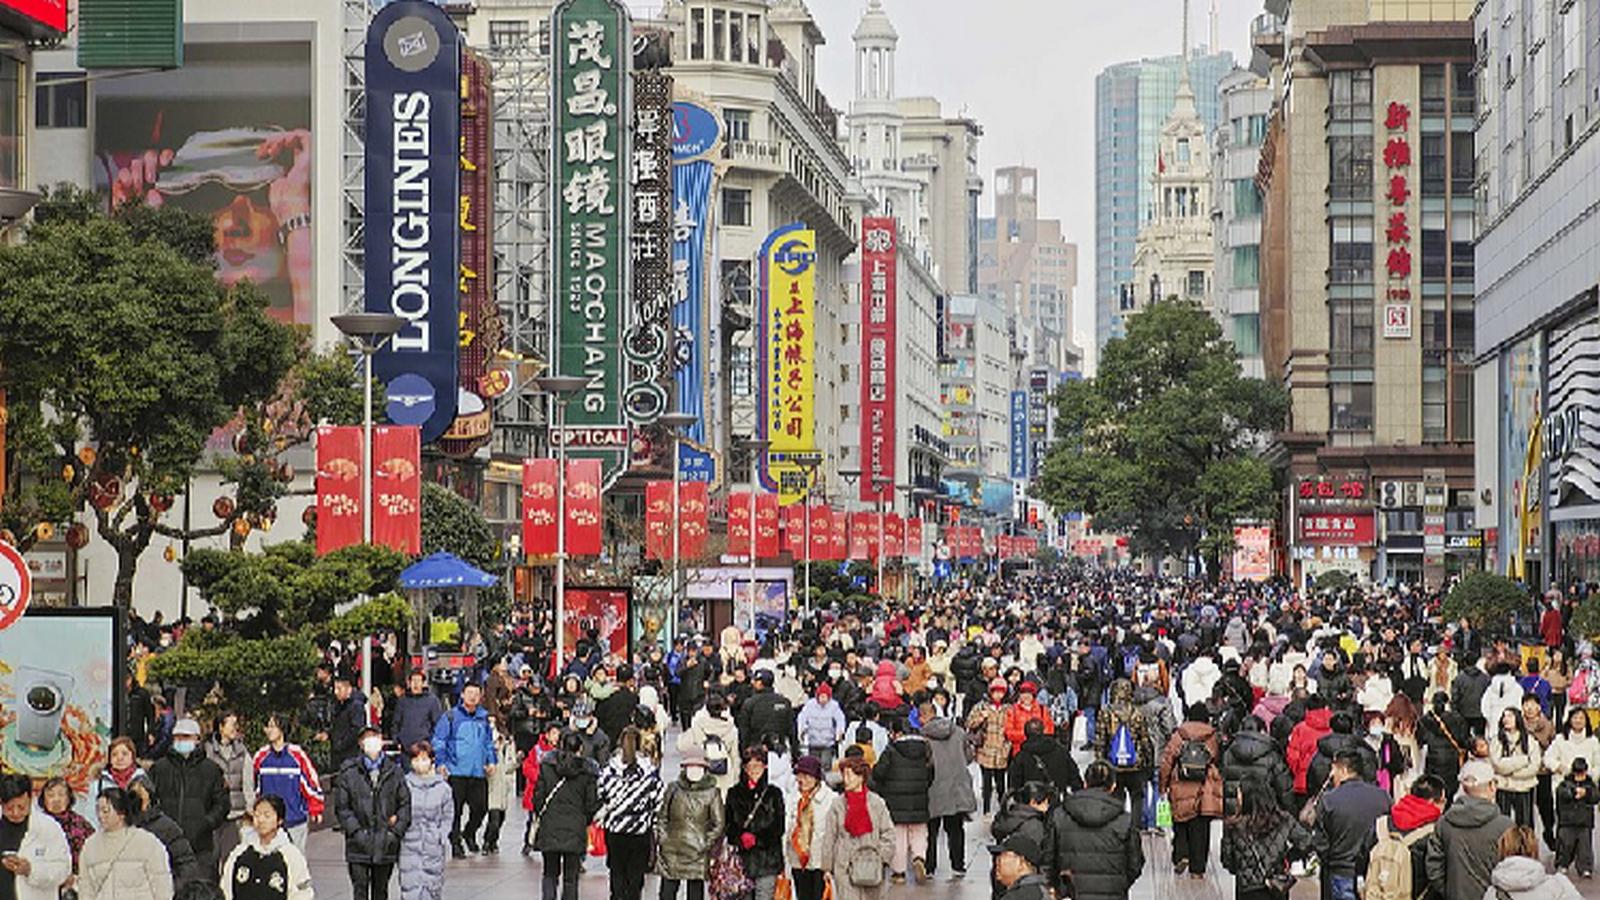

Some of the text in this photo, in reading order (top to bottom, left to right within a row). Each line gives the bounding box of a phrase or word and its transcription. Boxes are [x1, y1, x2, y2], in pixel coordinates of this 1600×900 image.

[564, 20, 617, 215] 茂昌眼镜
[391, 90, 430, 353] LONGINES
[570, 223, 581, 268] SINCE
[584, 223, 606, 413] MAOCHANG
[551, 430, 627, 445] OPTICAL
